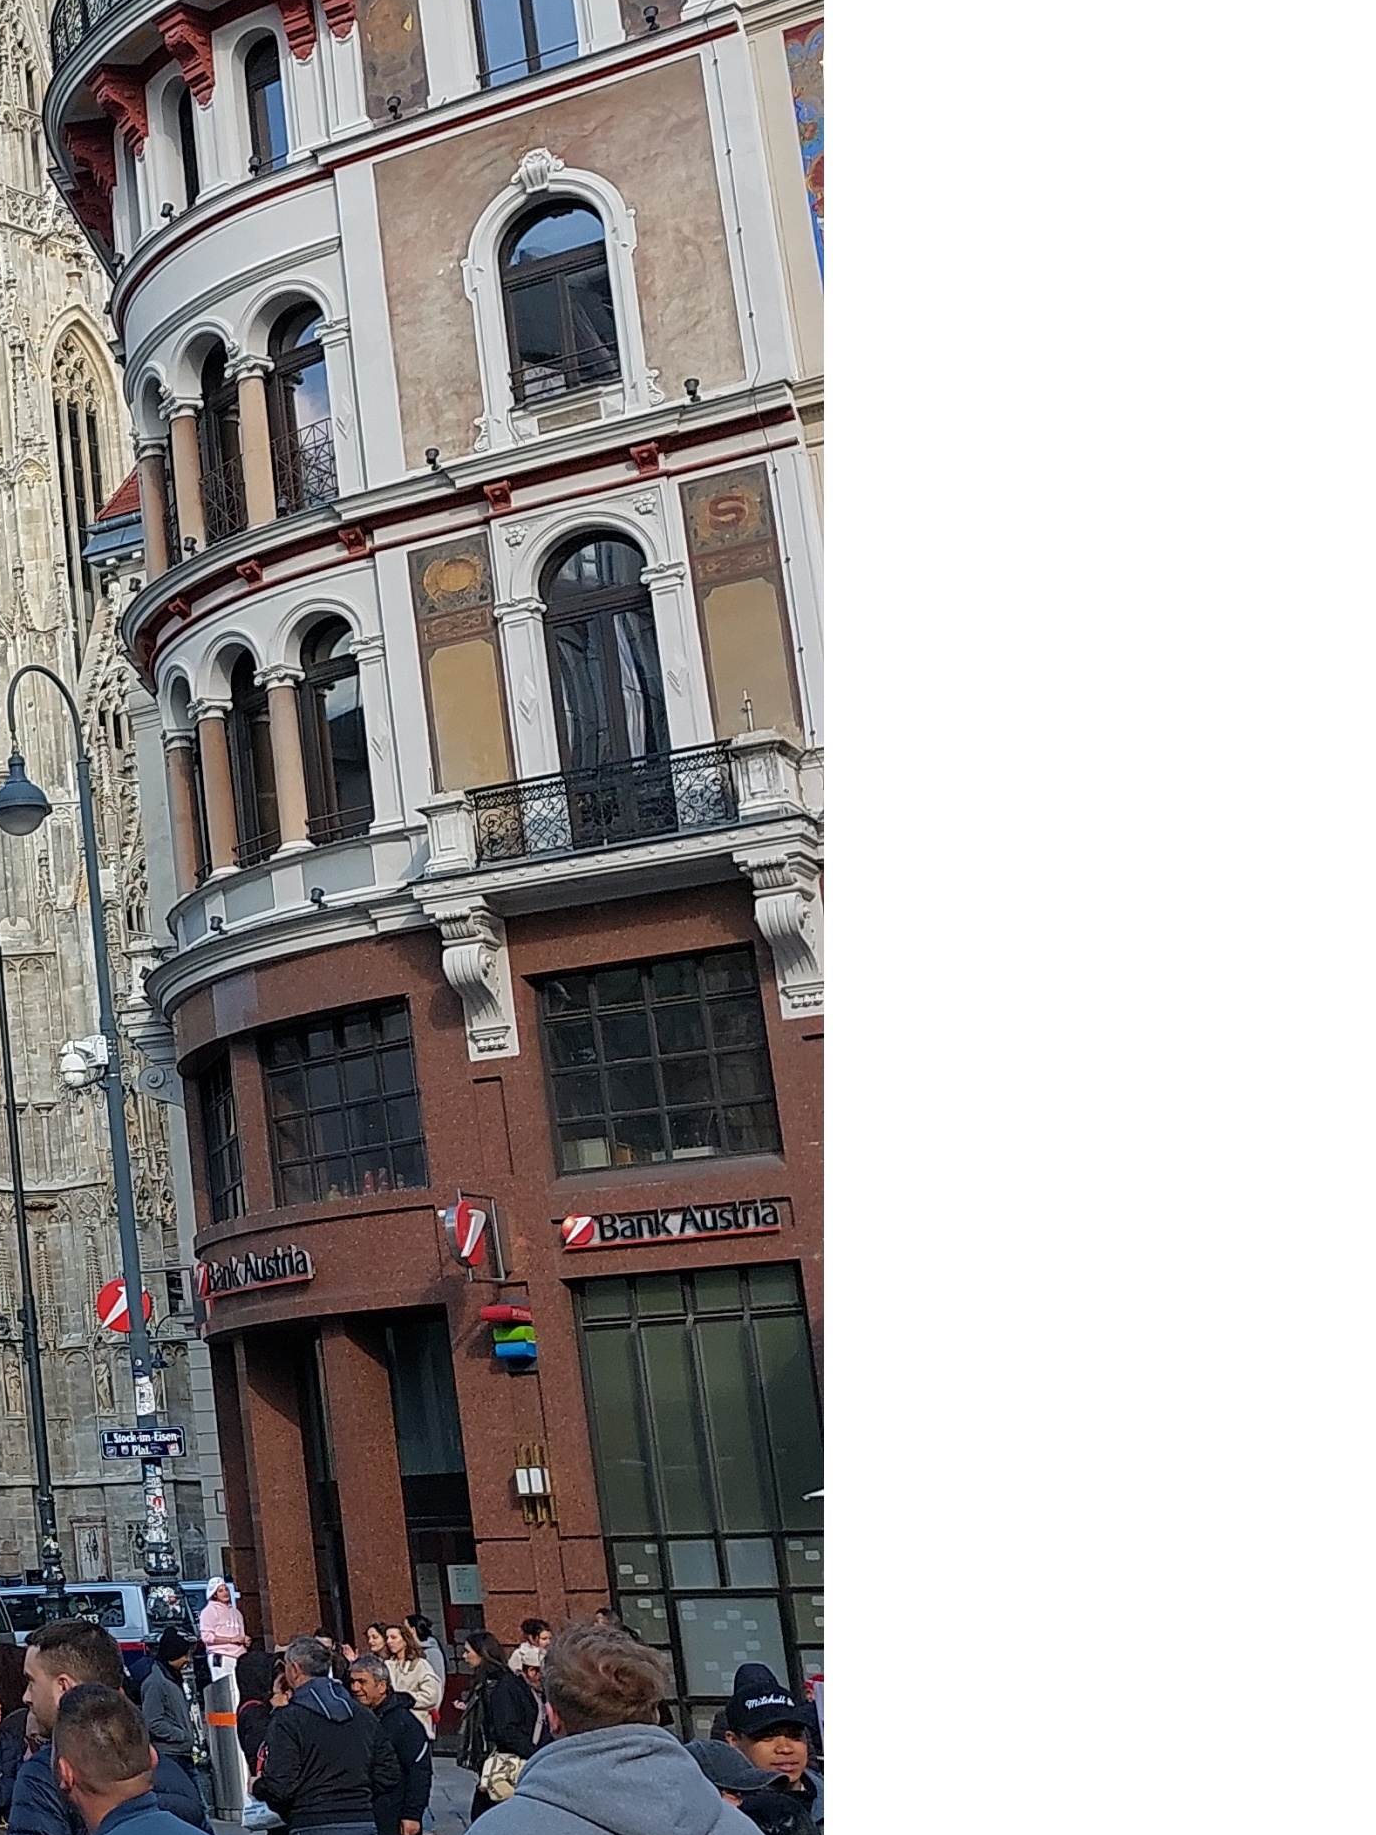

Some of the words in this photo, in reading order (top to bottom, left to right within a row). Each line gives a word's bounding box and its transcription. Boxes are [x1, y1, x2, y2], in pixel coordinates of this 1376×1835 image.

[600, 1211, 672, 1242] Bank
[678, 1200, 779, 1234] Austria
[209, 1256, 243, 1292] Bank
[244, 1244, 310, 1284] Austria
